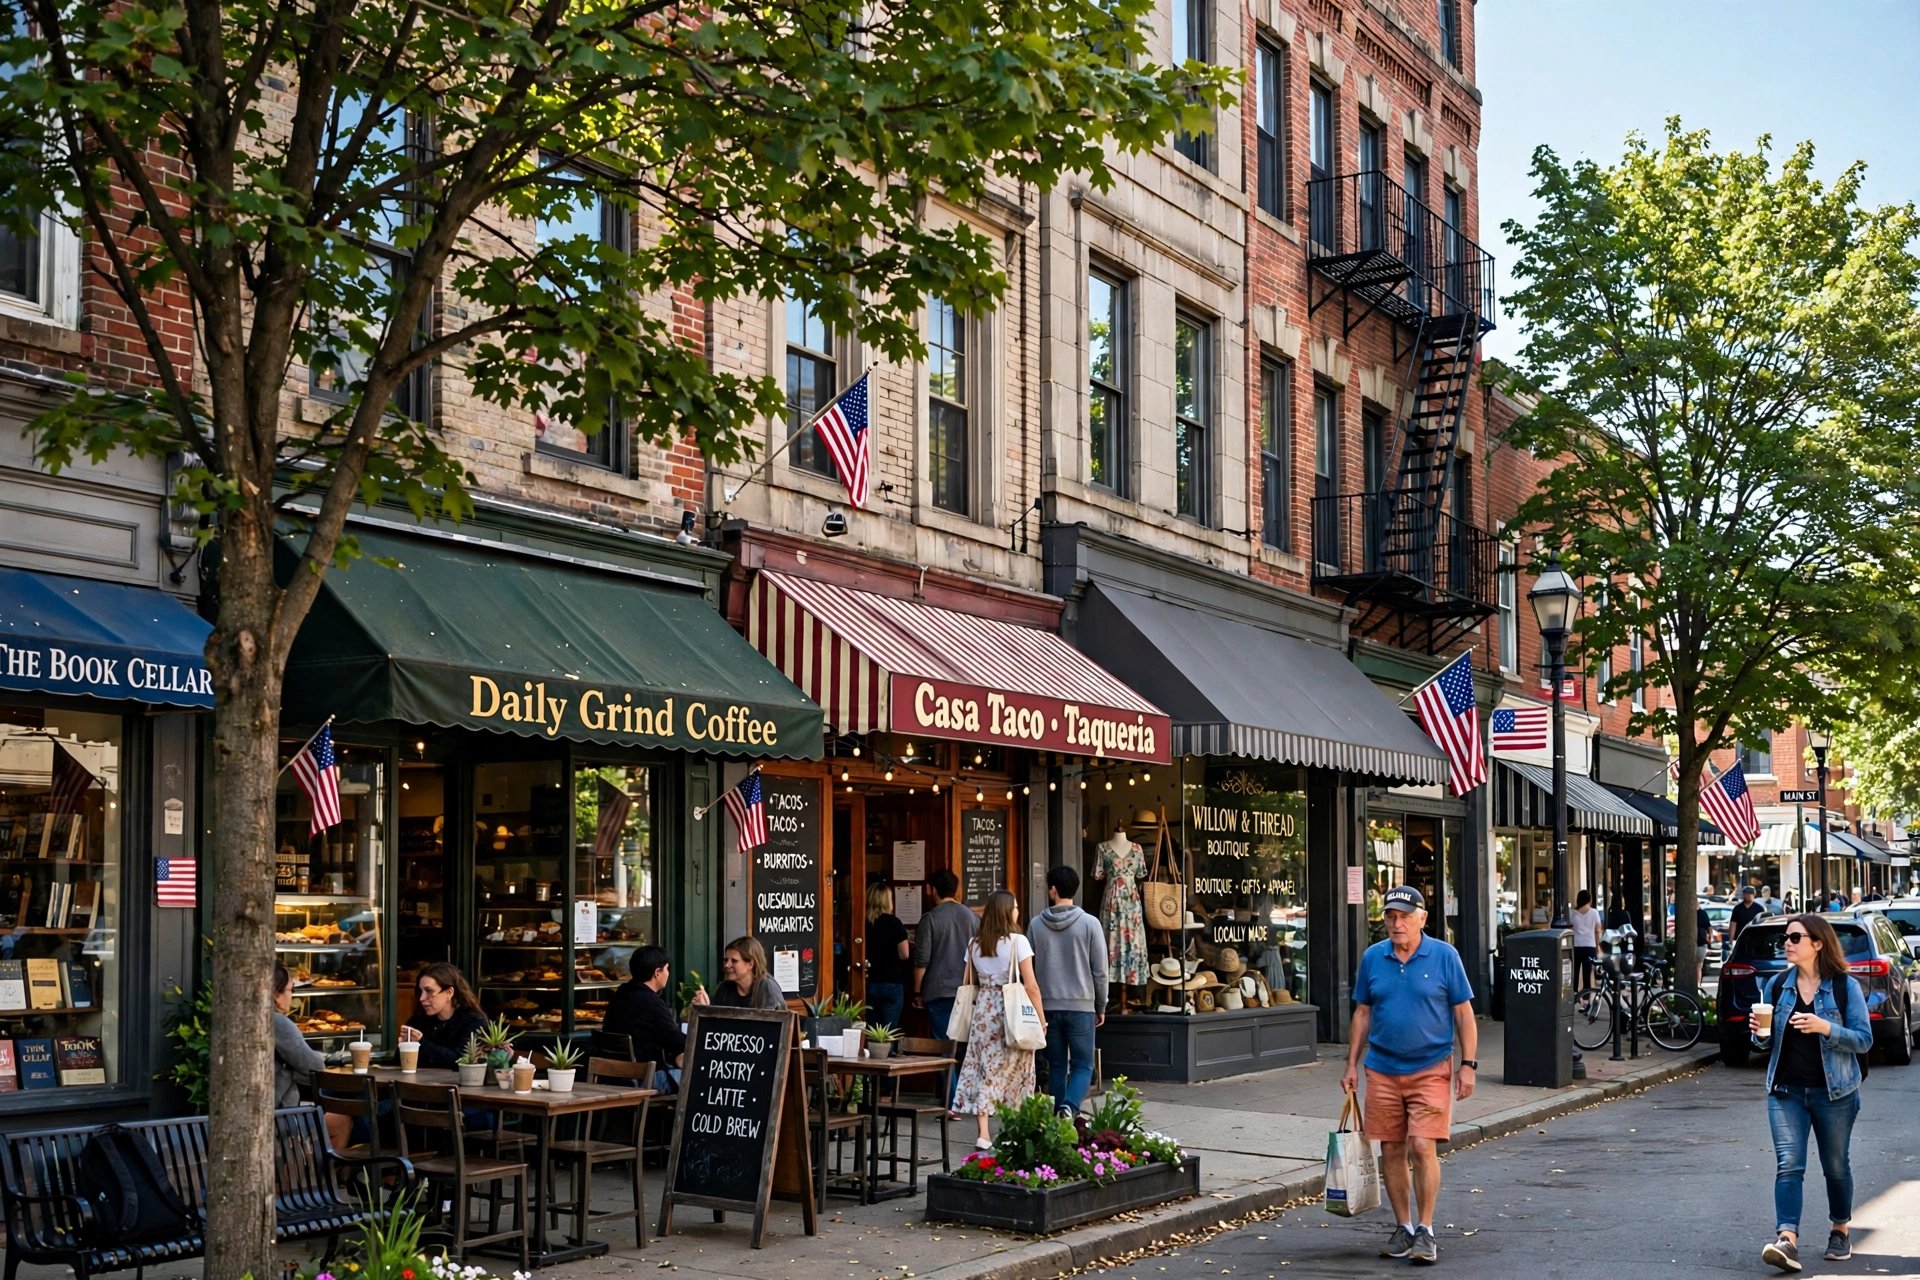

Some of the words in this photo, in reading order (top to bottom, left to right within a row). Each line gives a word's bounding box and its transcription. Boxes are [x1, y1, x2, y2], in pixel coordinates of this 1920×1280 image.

[0, 643, 41, 679] THE
[49, 647, 120, 687] BOOK
[127, 657, 215, 696] CELLAR
[469, 674, 568, 737] Daily
[578, 689, 675, 738] Grind
[685, 701, 778, 746] Coffee
[914, 681, 980, 733] Casa
[987, 691, 1045, 741] Taco
[1063, 703, 1156, 758] Taqueria
[773, 793, 803, 811] TACOS
[1806, 791, 1816, 800] ST
[767, 815, 799, 833] TACOS
[972, 817, 996, 831] TACOS
[1192, 805, 1239, 833] WILLOW
[1241, 810, 1250, 834] &
[1252, 811, 1295, 838] THREAD
[1207, 839, 1250, 860] BOUTIQUE
[763, 853, 807, 870] BURRITOS
[1195, 877, 1233, 897] BOUTIQUE
[1241, 880, 1261, 895] GIFTS
[757, 892, 816, 911] QUESADILLAS
[759, 915, 815, 934] MARGARITAS
[1214, 926, 1247, 943] LOCALLY
[1520, 956, 1540, 968] THE
[1510, 968, 1550, 981] NEWARK
[1517, 982, 1543, 995] POST
[704, 1032, 765, 1055] ESPRESSO
[708, 1059, 756, 1082] PASTRY
[707, 1086, 747, 1108] LATTE
[691, 1112, 722, 1134] COLD
[725, 1116, 761, 1139] BREW
